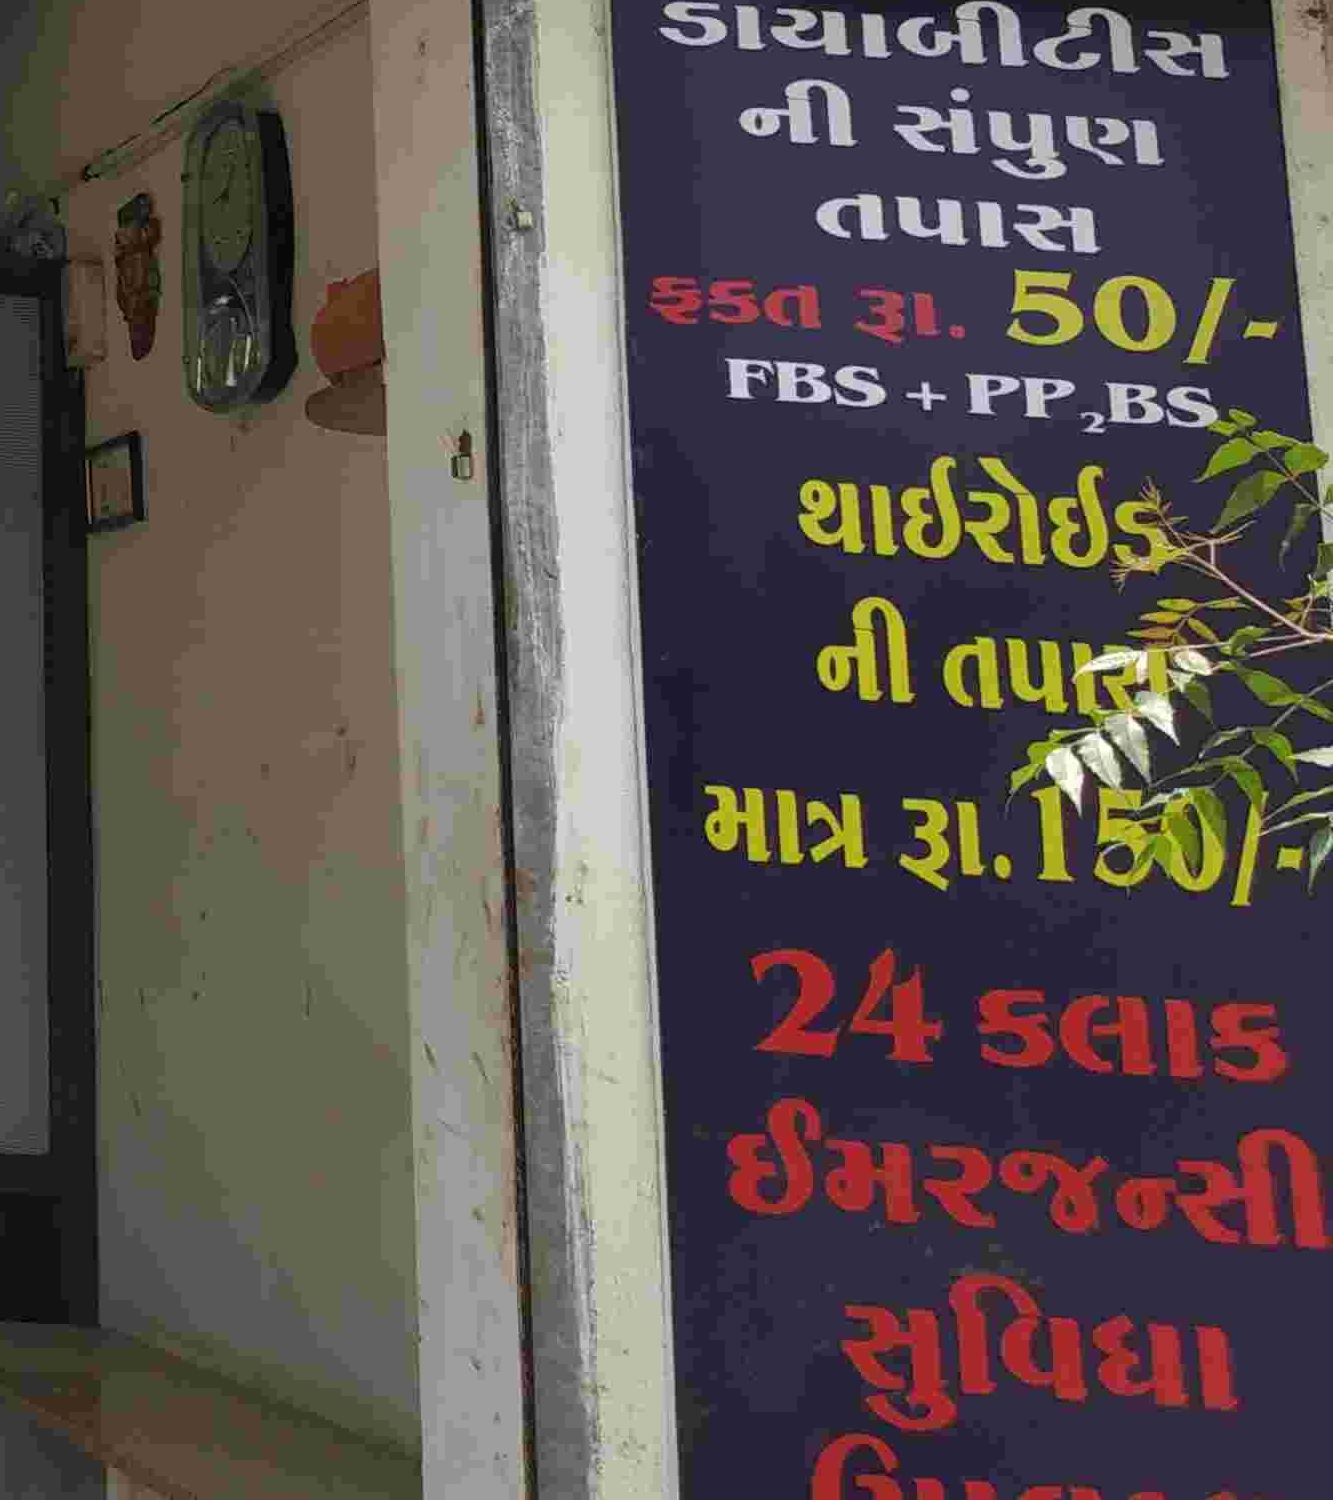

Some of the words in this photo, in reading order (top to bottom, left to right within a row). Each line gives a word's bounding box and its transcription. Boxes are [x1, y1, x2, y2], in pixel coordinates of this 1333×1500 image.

[658, 0, 1231, 79] ડાયાબીટીસ
[737, 78, 858, 148] ની
[892, 86, 1166, 181] સંપુણ
[815, 192, 1103, 255] તપાસ
[647, 274, 822, 329] ફકત
[1004, 269, 1284, 365] 50/-
[724, 357, 888, 409] FBS
[815, 595, 916, 704] ની
[703, 785, 869, 870] માત્ર
[749, 946, 944, 1063] 24
[978, 987, 1290, 1085] કલાક
[841, 1273, 1240, 1432] સુવિધા
